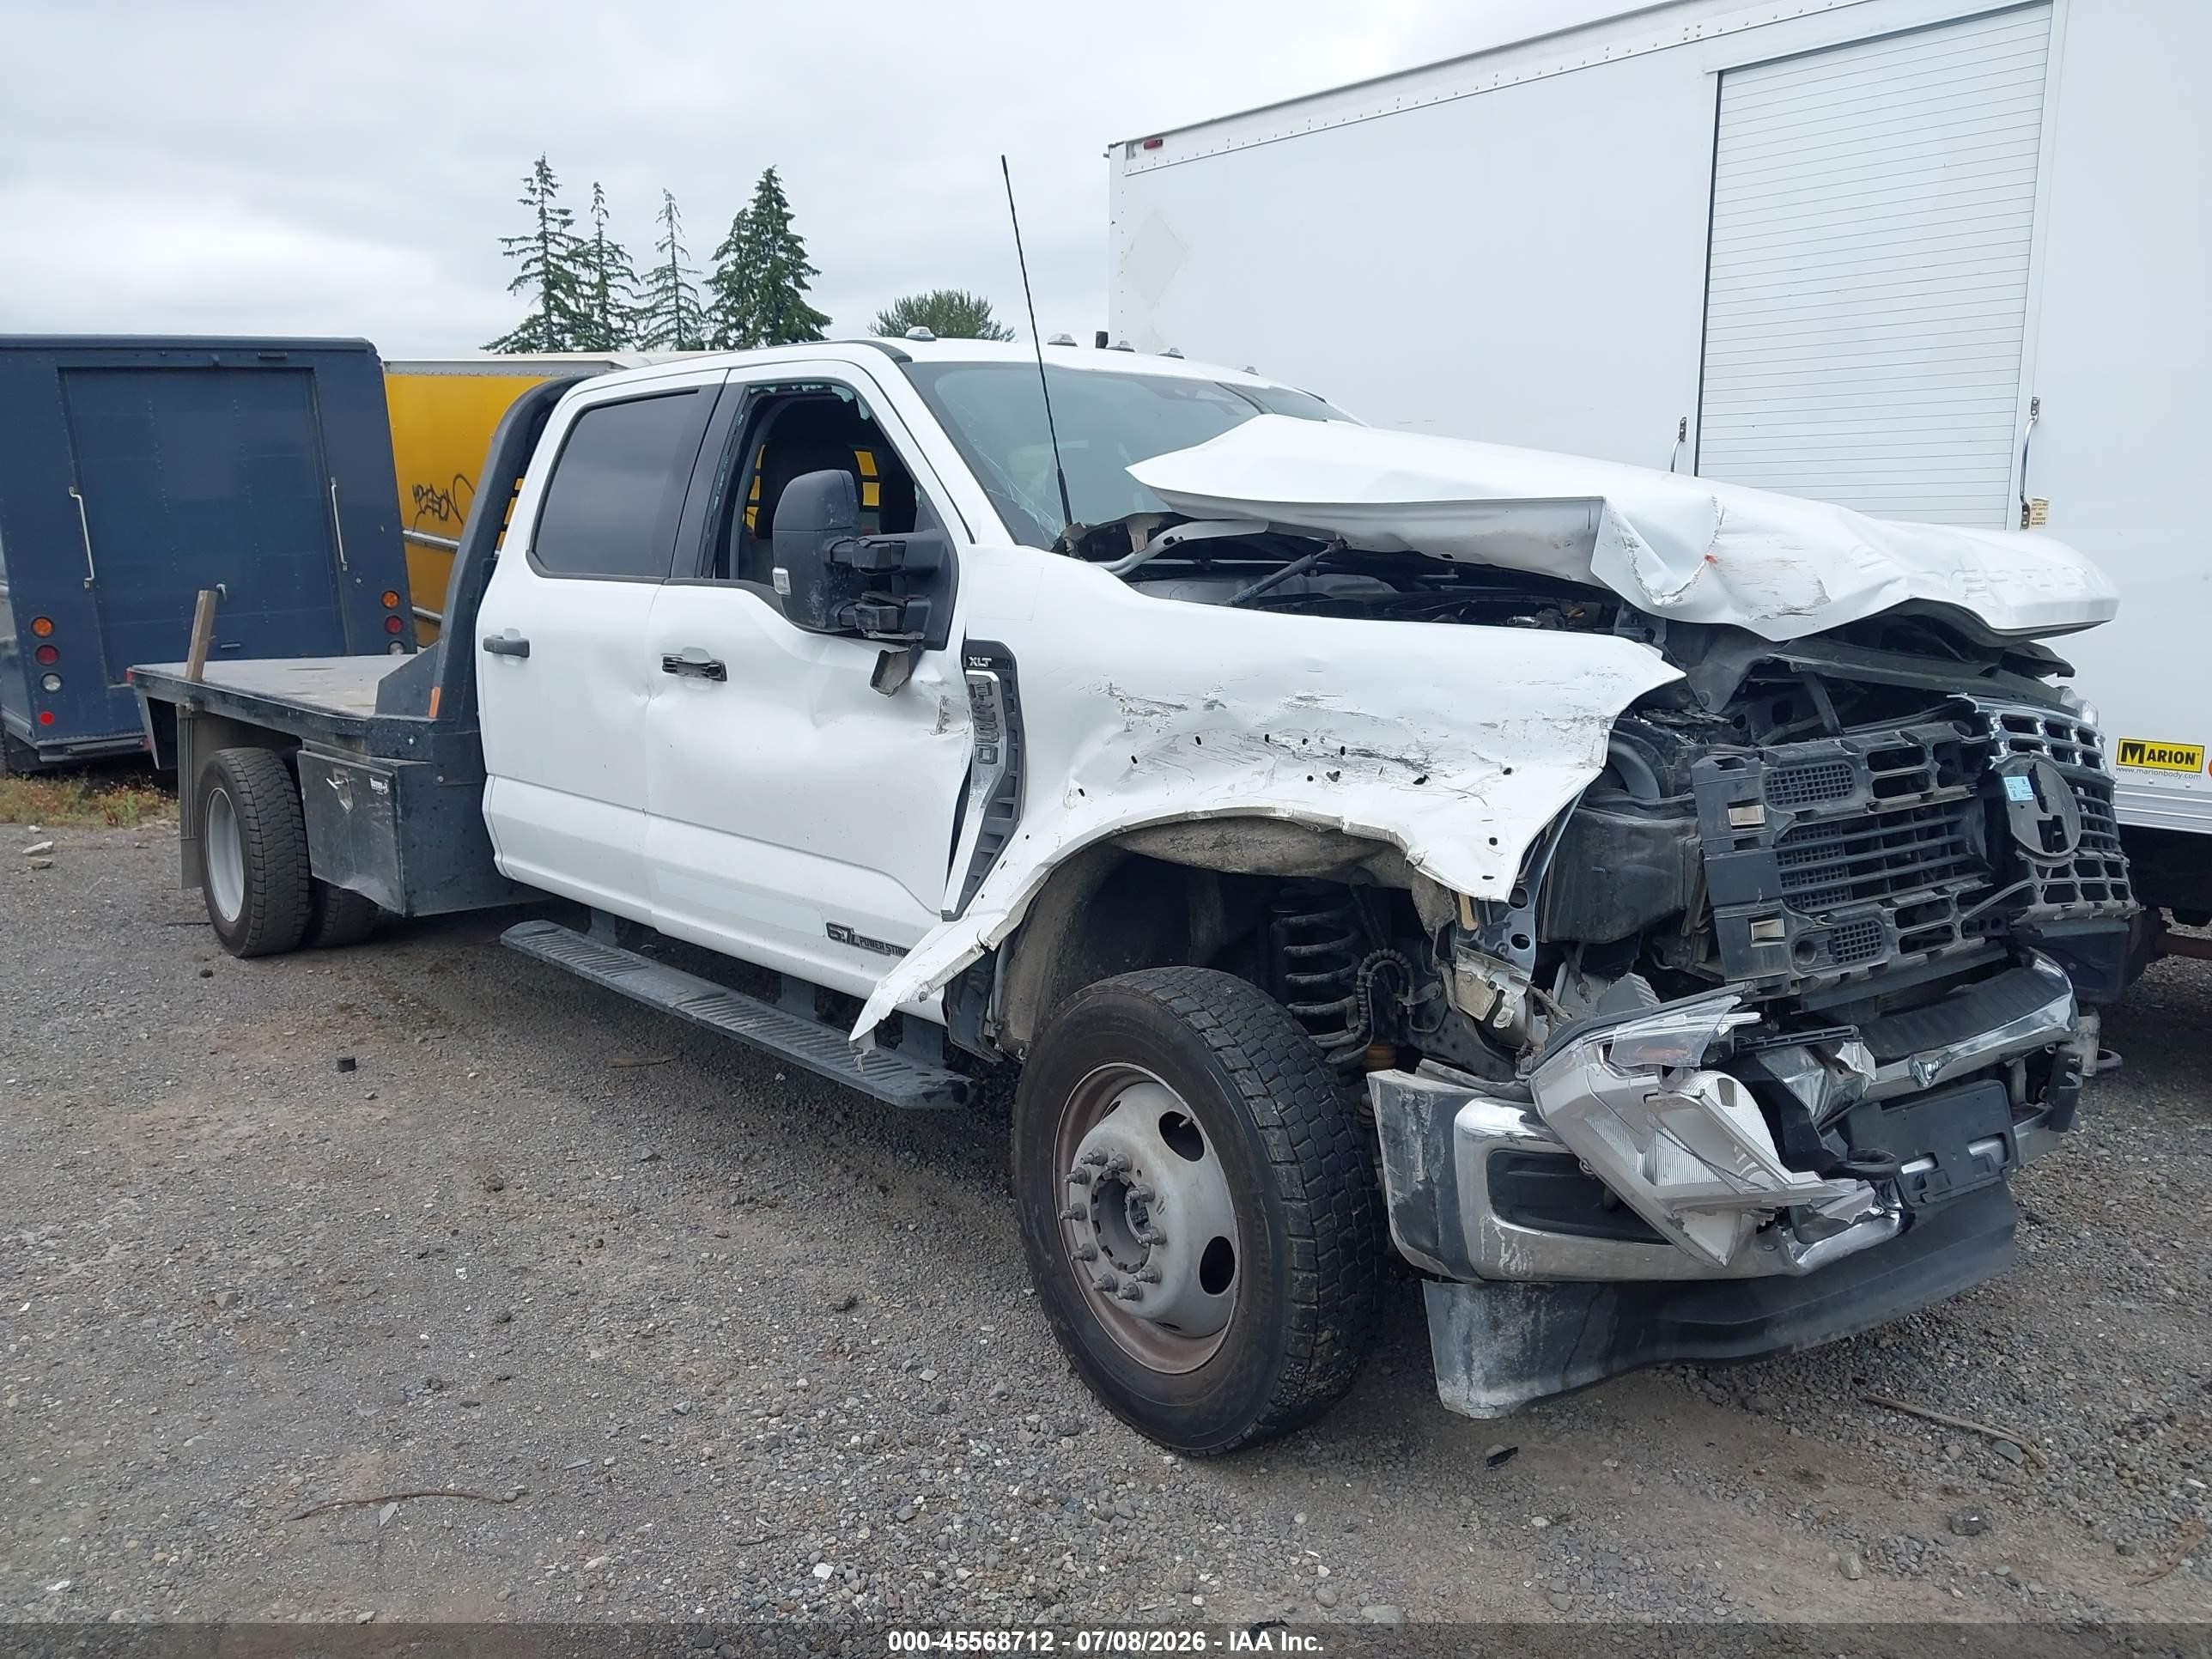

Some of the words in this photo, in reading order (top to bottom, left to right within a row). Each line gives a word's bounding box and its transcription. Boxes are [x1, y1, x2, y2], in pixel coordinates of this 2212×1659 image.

[969, 656, 993, 667] XLT
[2120, 741, 2197, 766] MARION
[2115, 766, 2202, 781] www.marionbody.com
[826, 922, 860, 948] 6.7L
[860, 936, 884, 951] POWER
